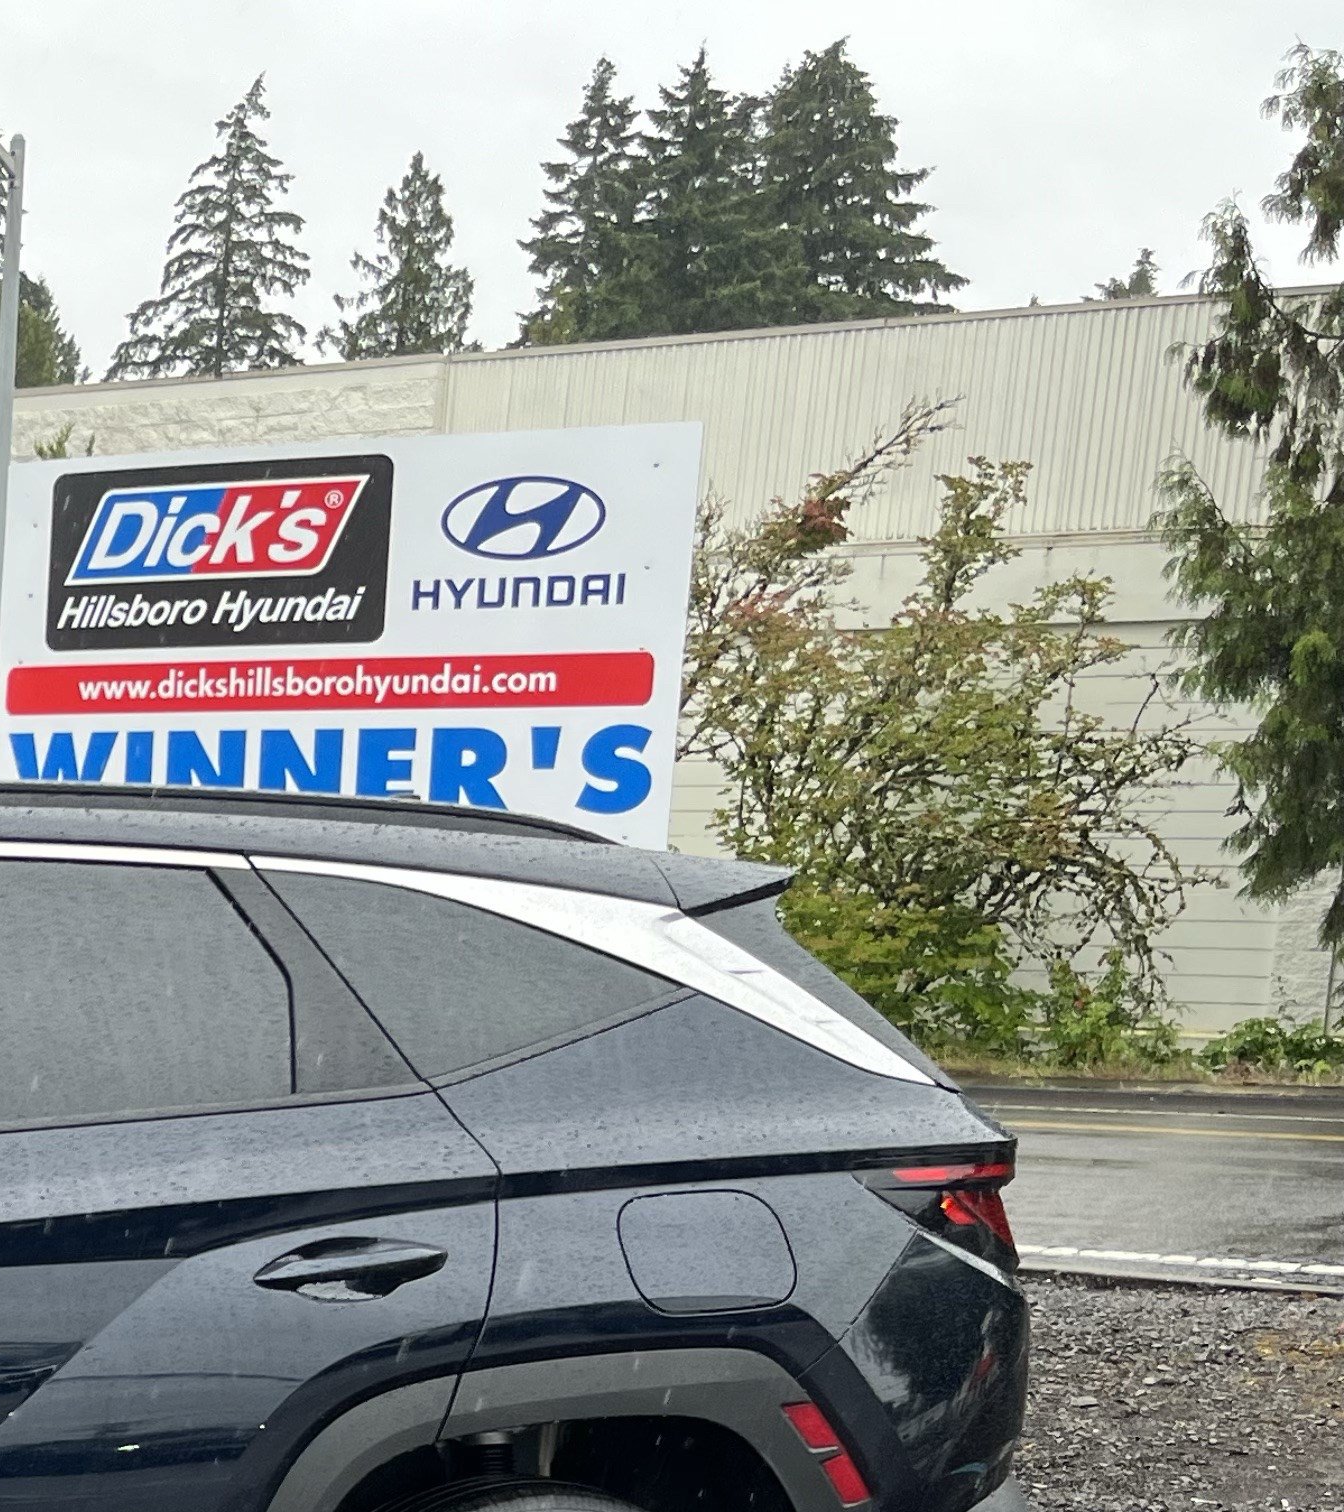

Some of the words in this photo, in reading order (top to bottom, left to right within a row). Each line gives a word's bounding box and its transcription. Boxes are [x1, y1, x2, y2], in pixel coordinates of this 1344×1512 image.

[87, 490, 327, 570] Dick's
[57, 594, 207, 629] Hillsboro
[212, 586, 367, 632] Hyundai
[412, 573, 626, 610] HYUNDAI
[78, 662, 557, 704] www.dickshillsborohyundai.com
[9, 724, 653, 814] WINNER'S
